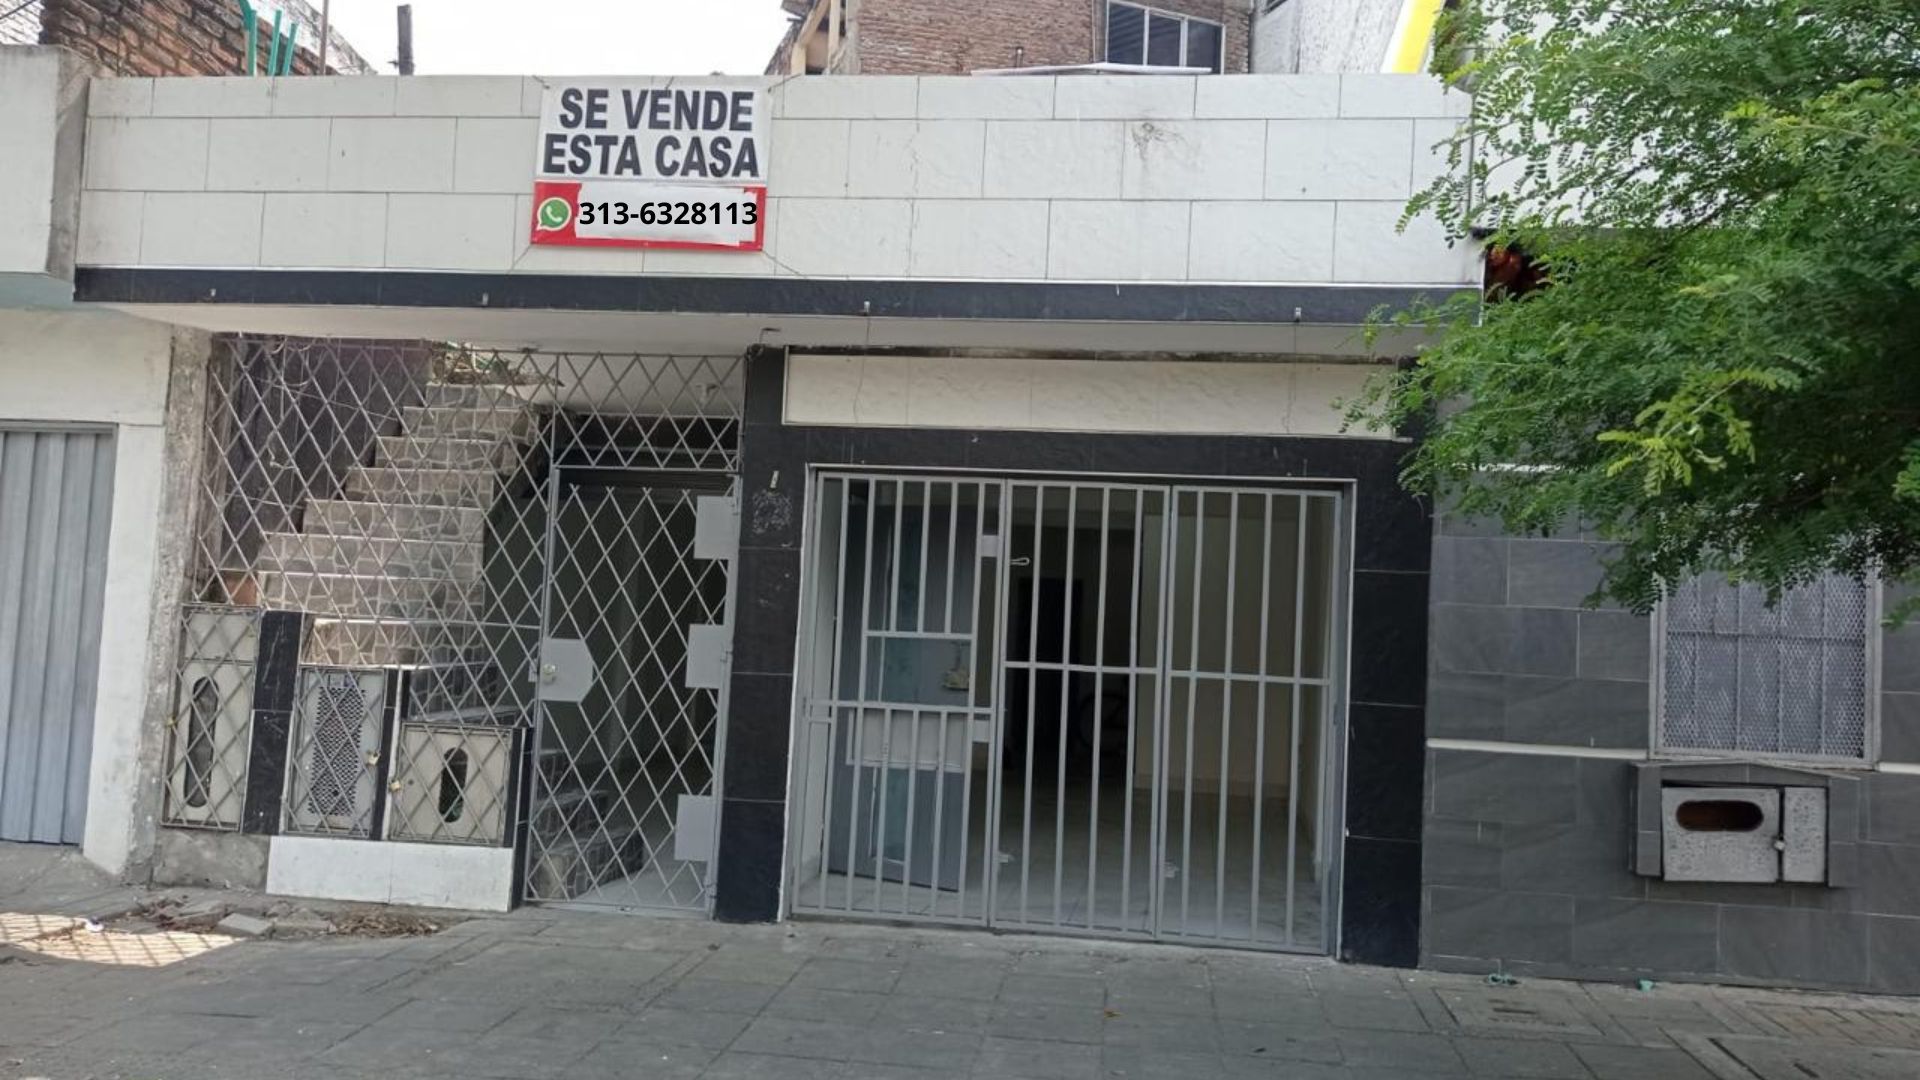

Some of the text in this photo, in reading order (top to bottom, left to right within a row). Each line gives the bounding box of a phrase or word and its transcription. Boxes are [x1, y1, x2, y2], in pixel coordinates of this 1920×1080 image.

[558, 87, 754, 132] SE VENDE
[543, 132, 759, 178] ESTA CASA
